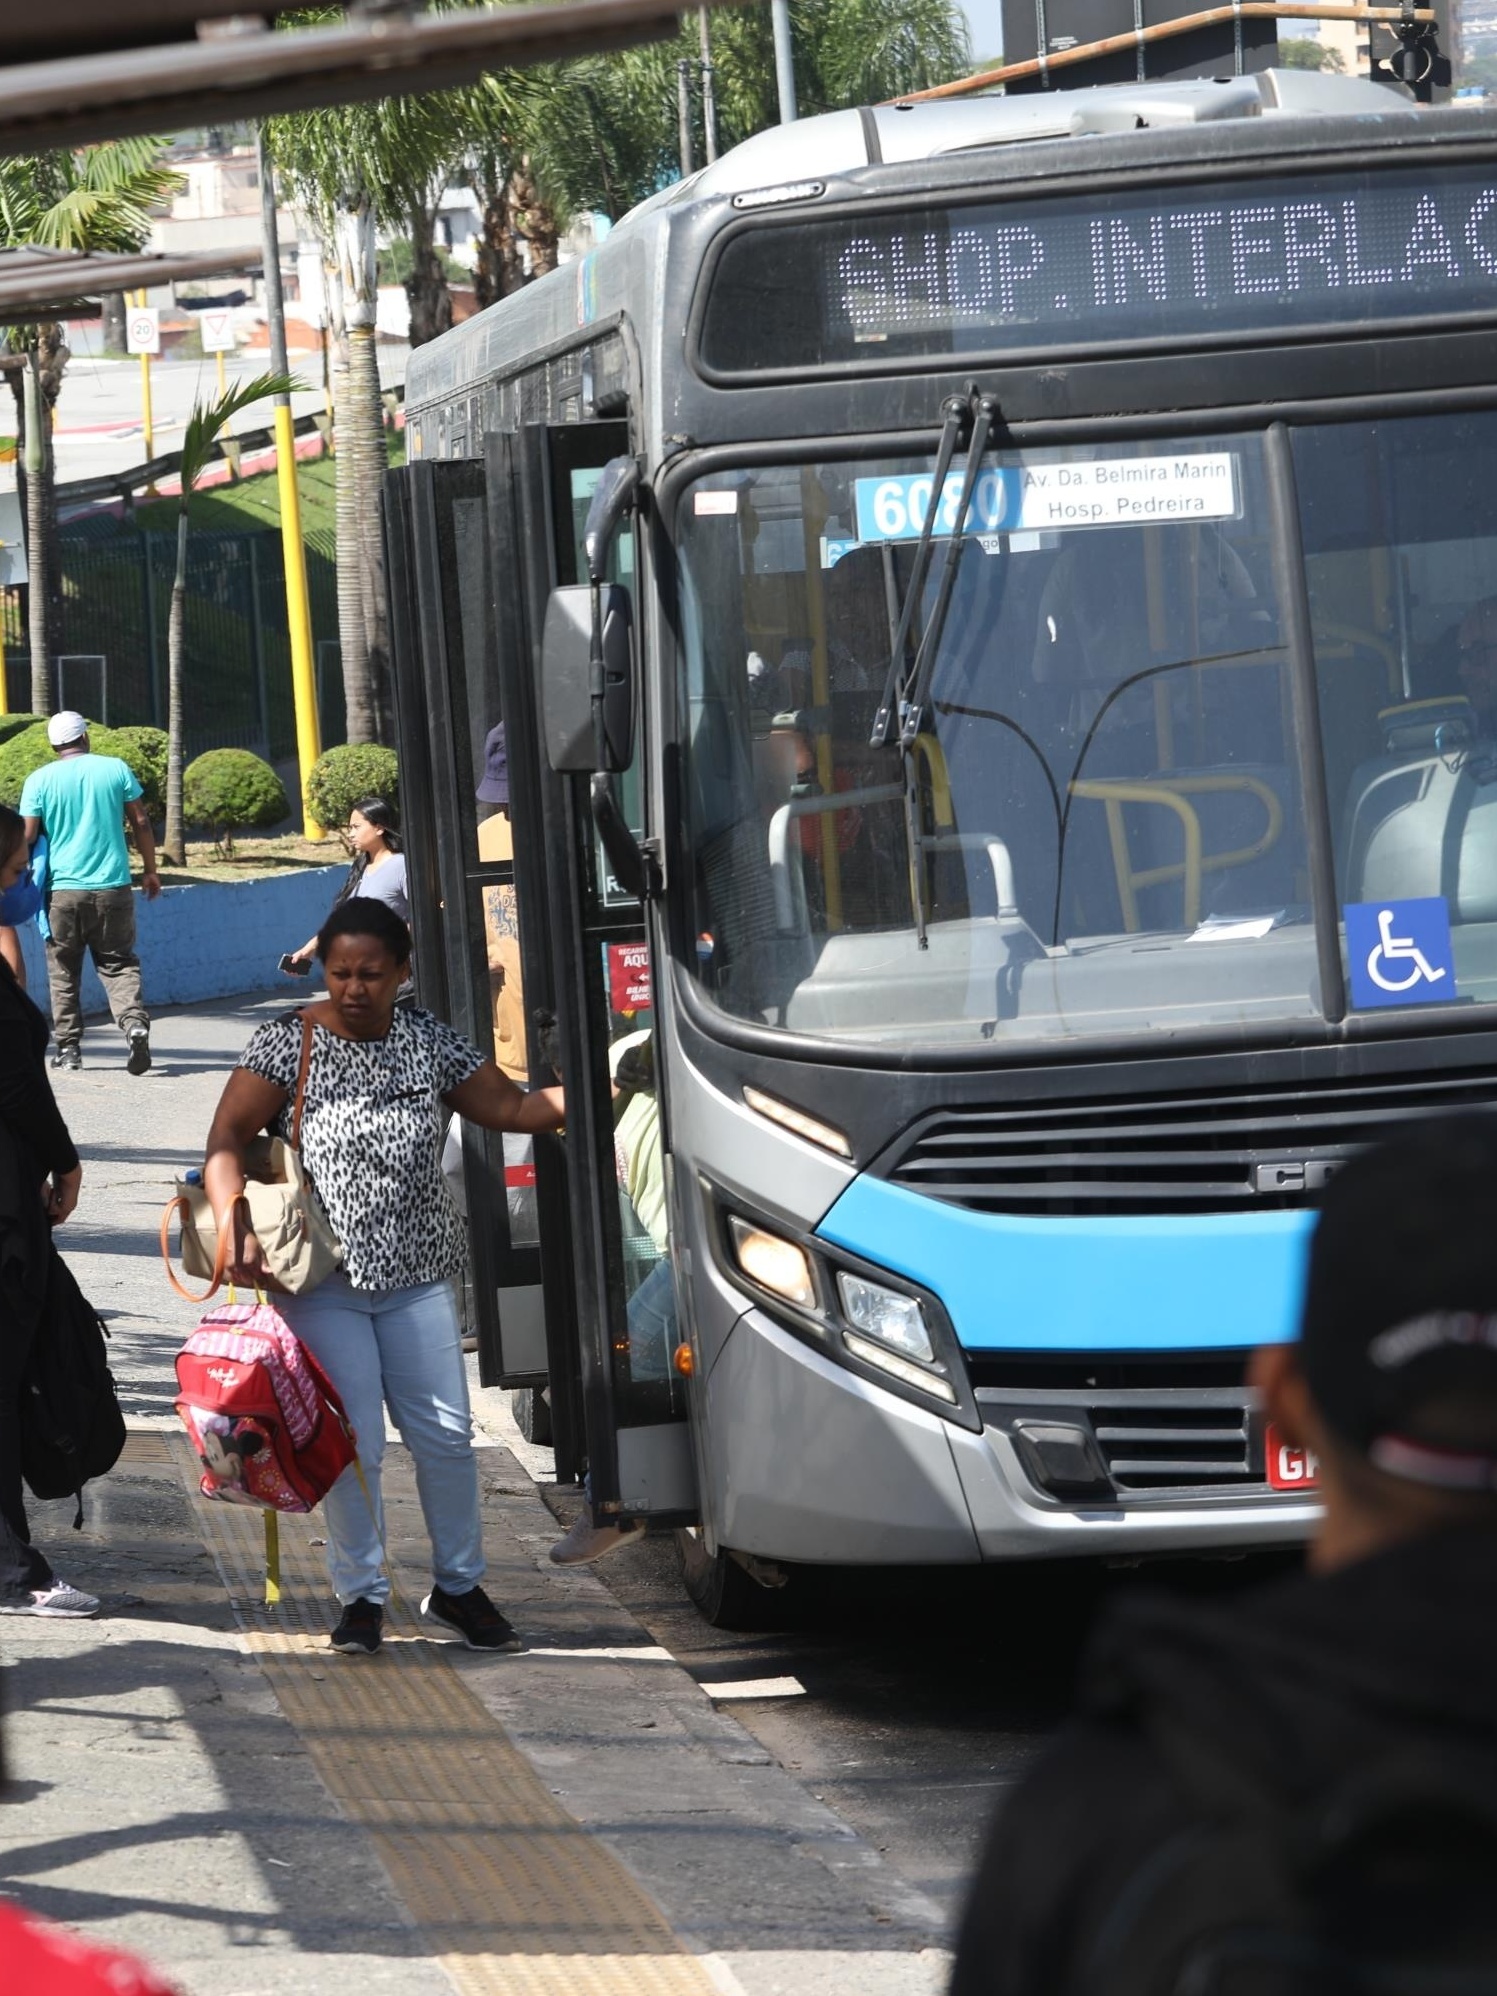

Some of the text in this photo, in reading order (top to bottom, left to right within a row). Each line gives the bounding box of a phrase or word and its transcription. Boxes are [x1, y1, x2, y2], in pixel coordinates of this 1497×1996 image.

[135, 325, 150, 335] 20
[1023, 461, 1226, 489] Av. Da. Belmira Marin
[873, 473, 1009, 536] 6080
[1049, 497, 1205, 520] Hosp. Pedreira
[623, 954, 649, 969] AQU
